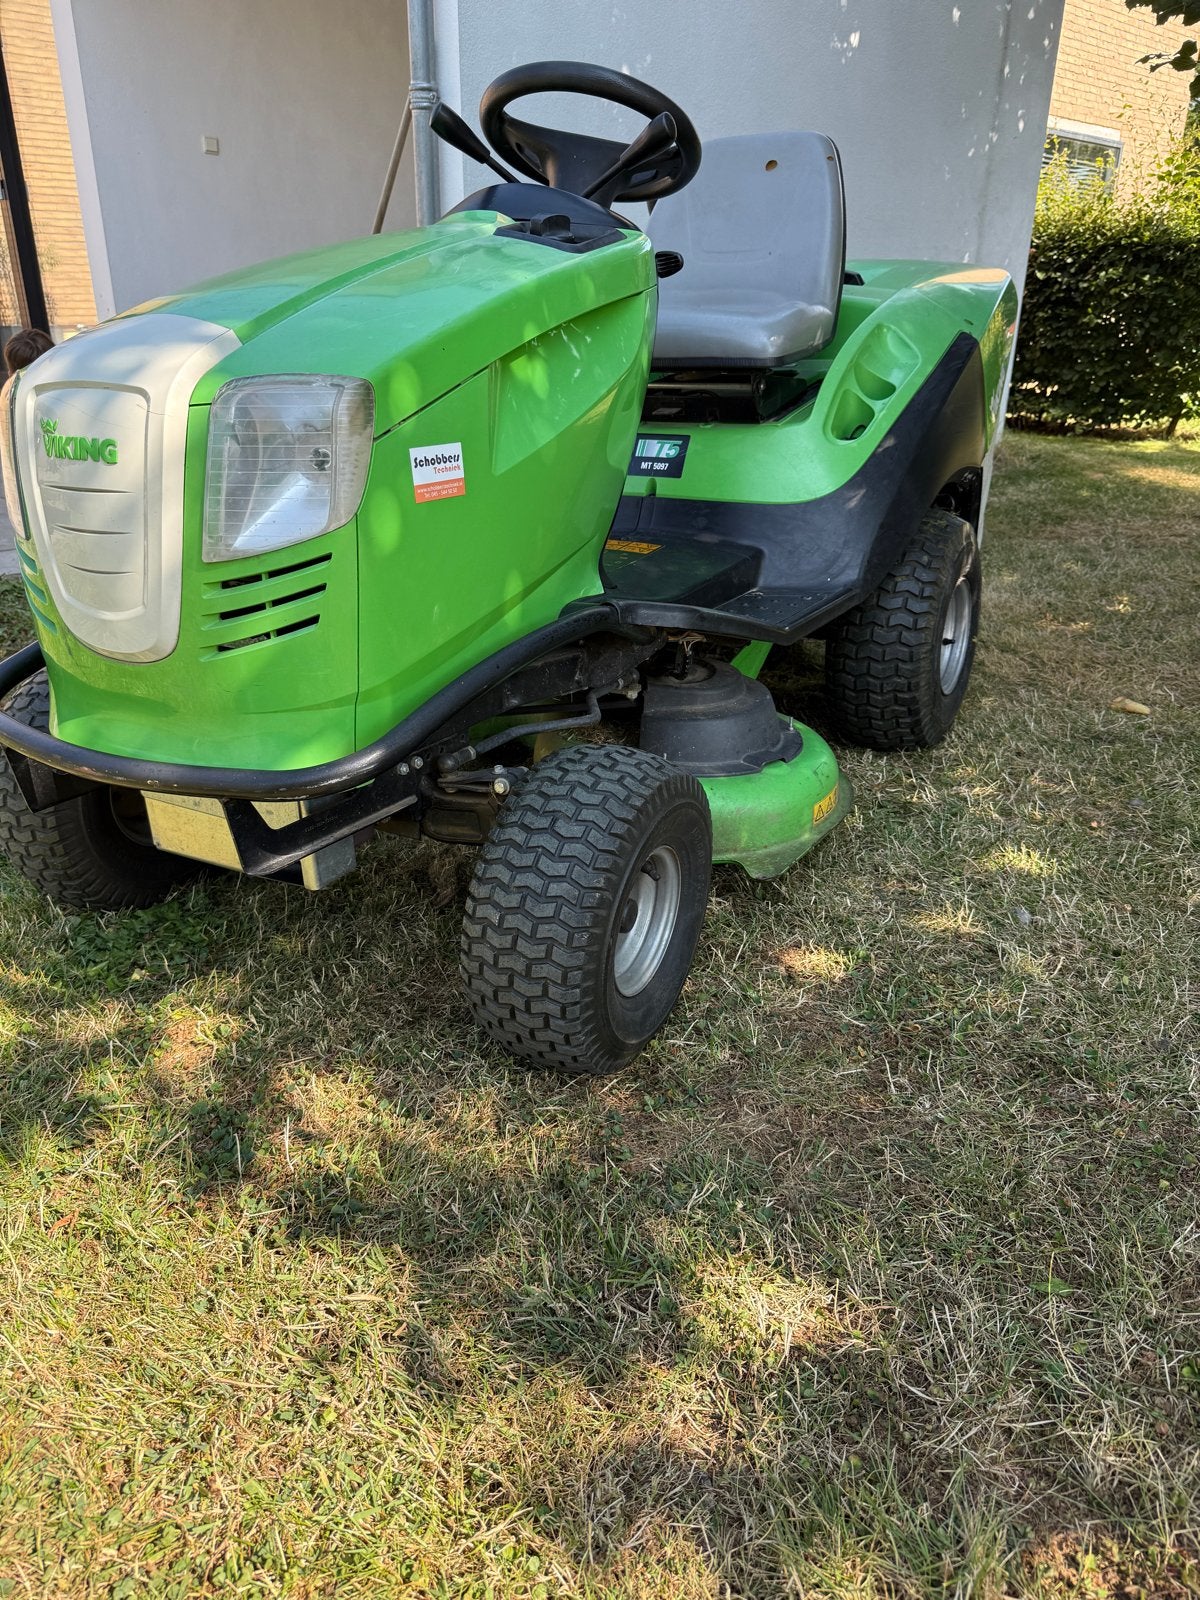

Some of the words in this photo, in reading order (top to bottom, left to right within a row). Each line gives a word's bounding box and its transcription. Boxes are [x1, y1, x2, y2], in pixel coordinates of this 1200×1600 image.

[42, 433, 119, 465] VIKING
[656, 440, 683, 459] T5
[413, 453, 460, 469] Schobbers
[433, 464, 461, 474] Techniek
[640, 461, 652, 470] MT
[653, 462, 669, 471] 5097
